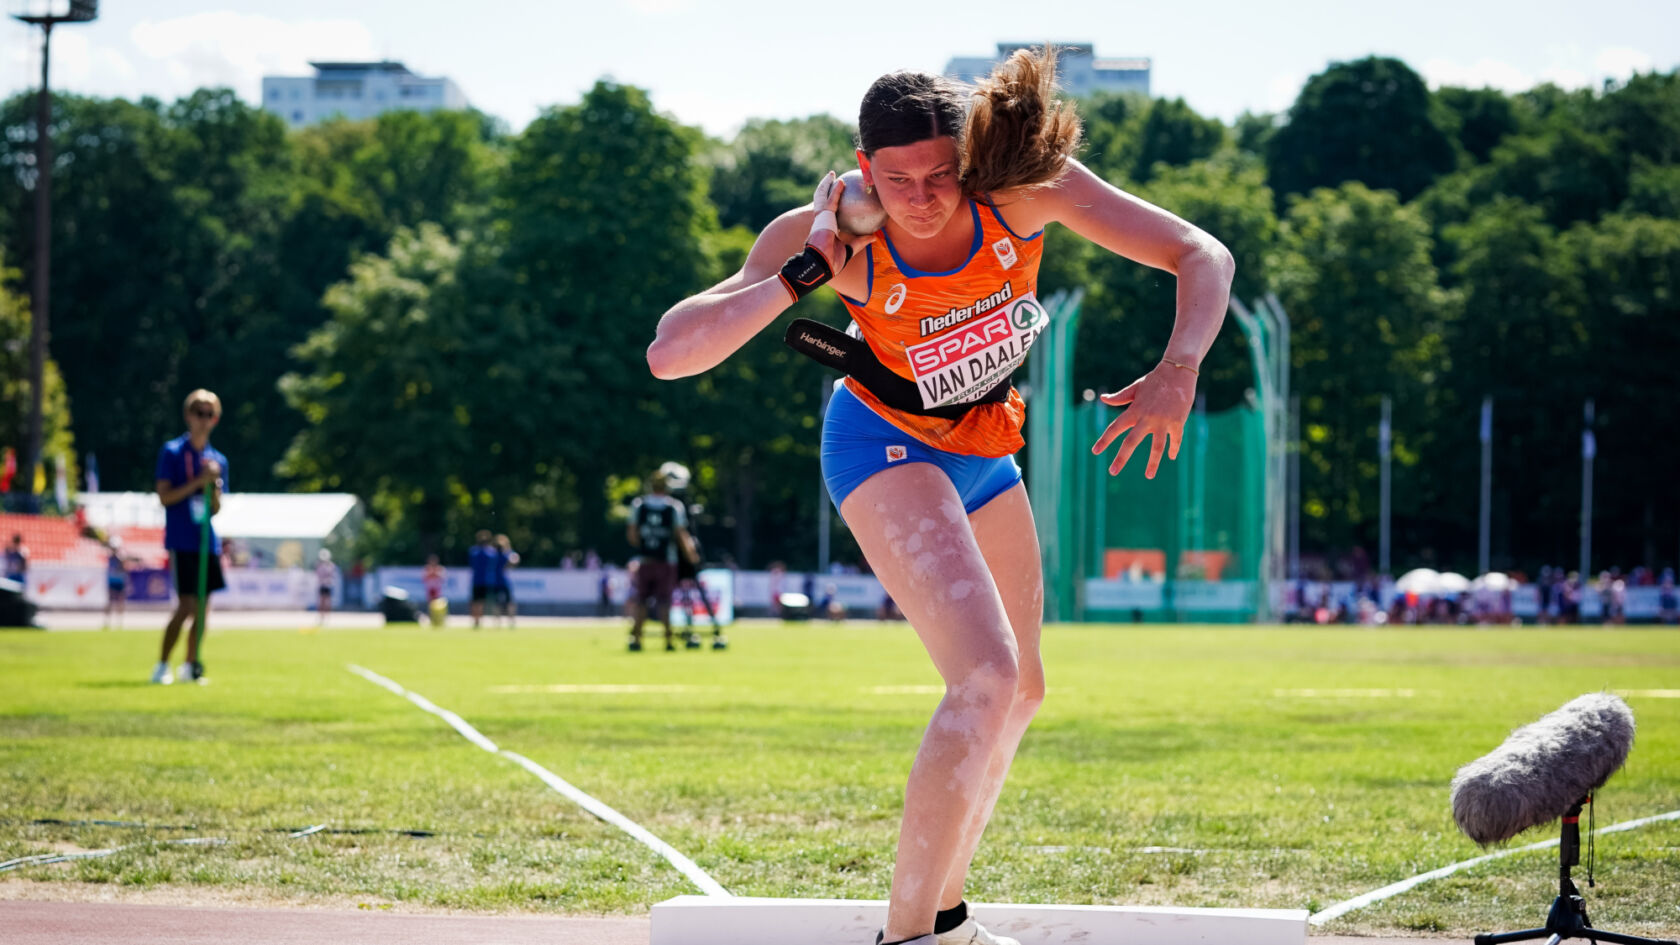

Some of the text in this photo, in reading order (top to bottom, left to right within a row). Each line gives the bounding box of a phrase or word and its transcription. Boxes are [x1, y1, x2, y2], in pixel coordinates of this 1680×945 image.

[800, 332, 846, 358] Harbinger
[914, 318, 1009, 371] SPAR
[923, 365, 966, 403] VAN
